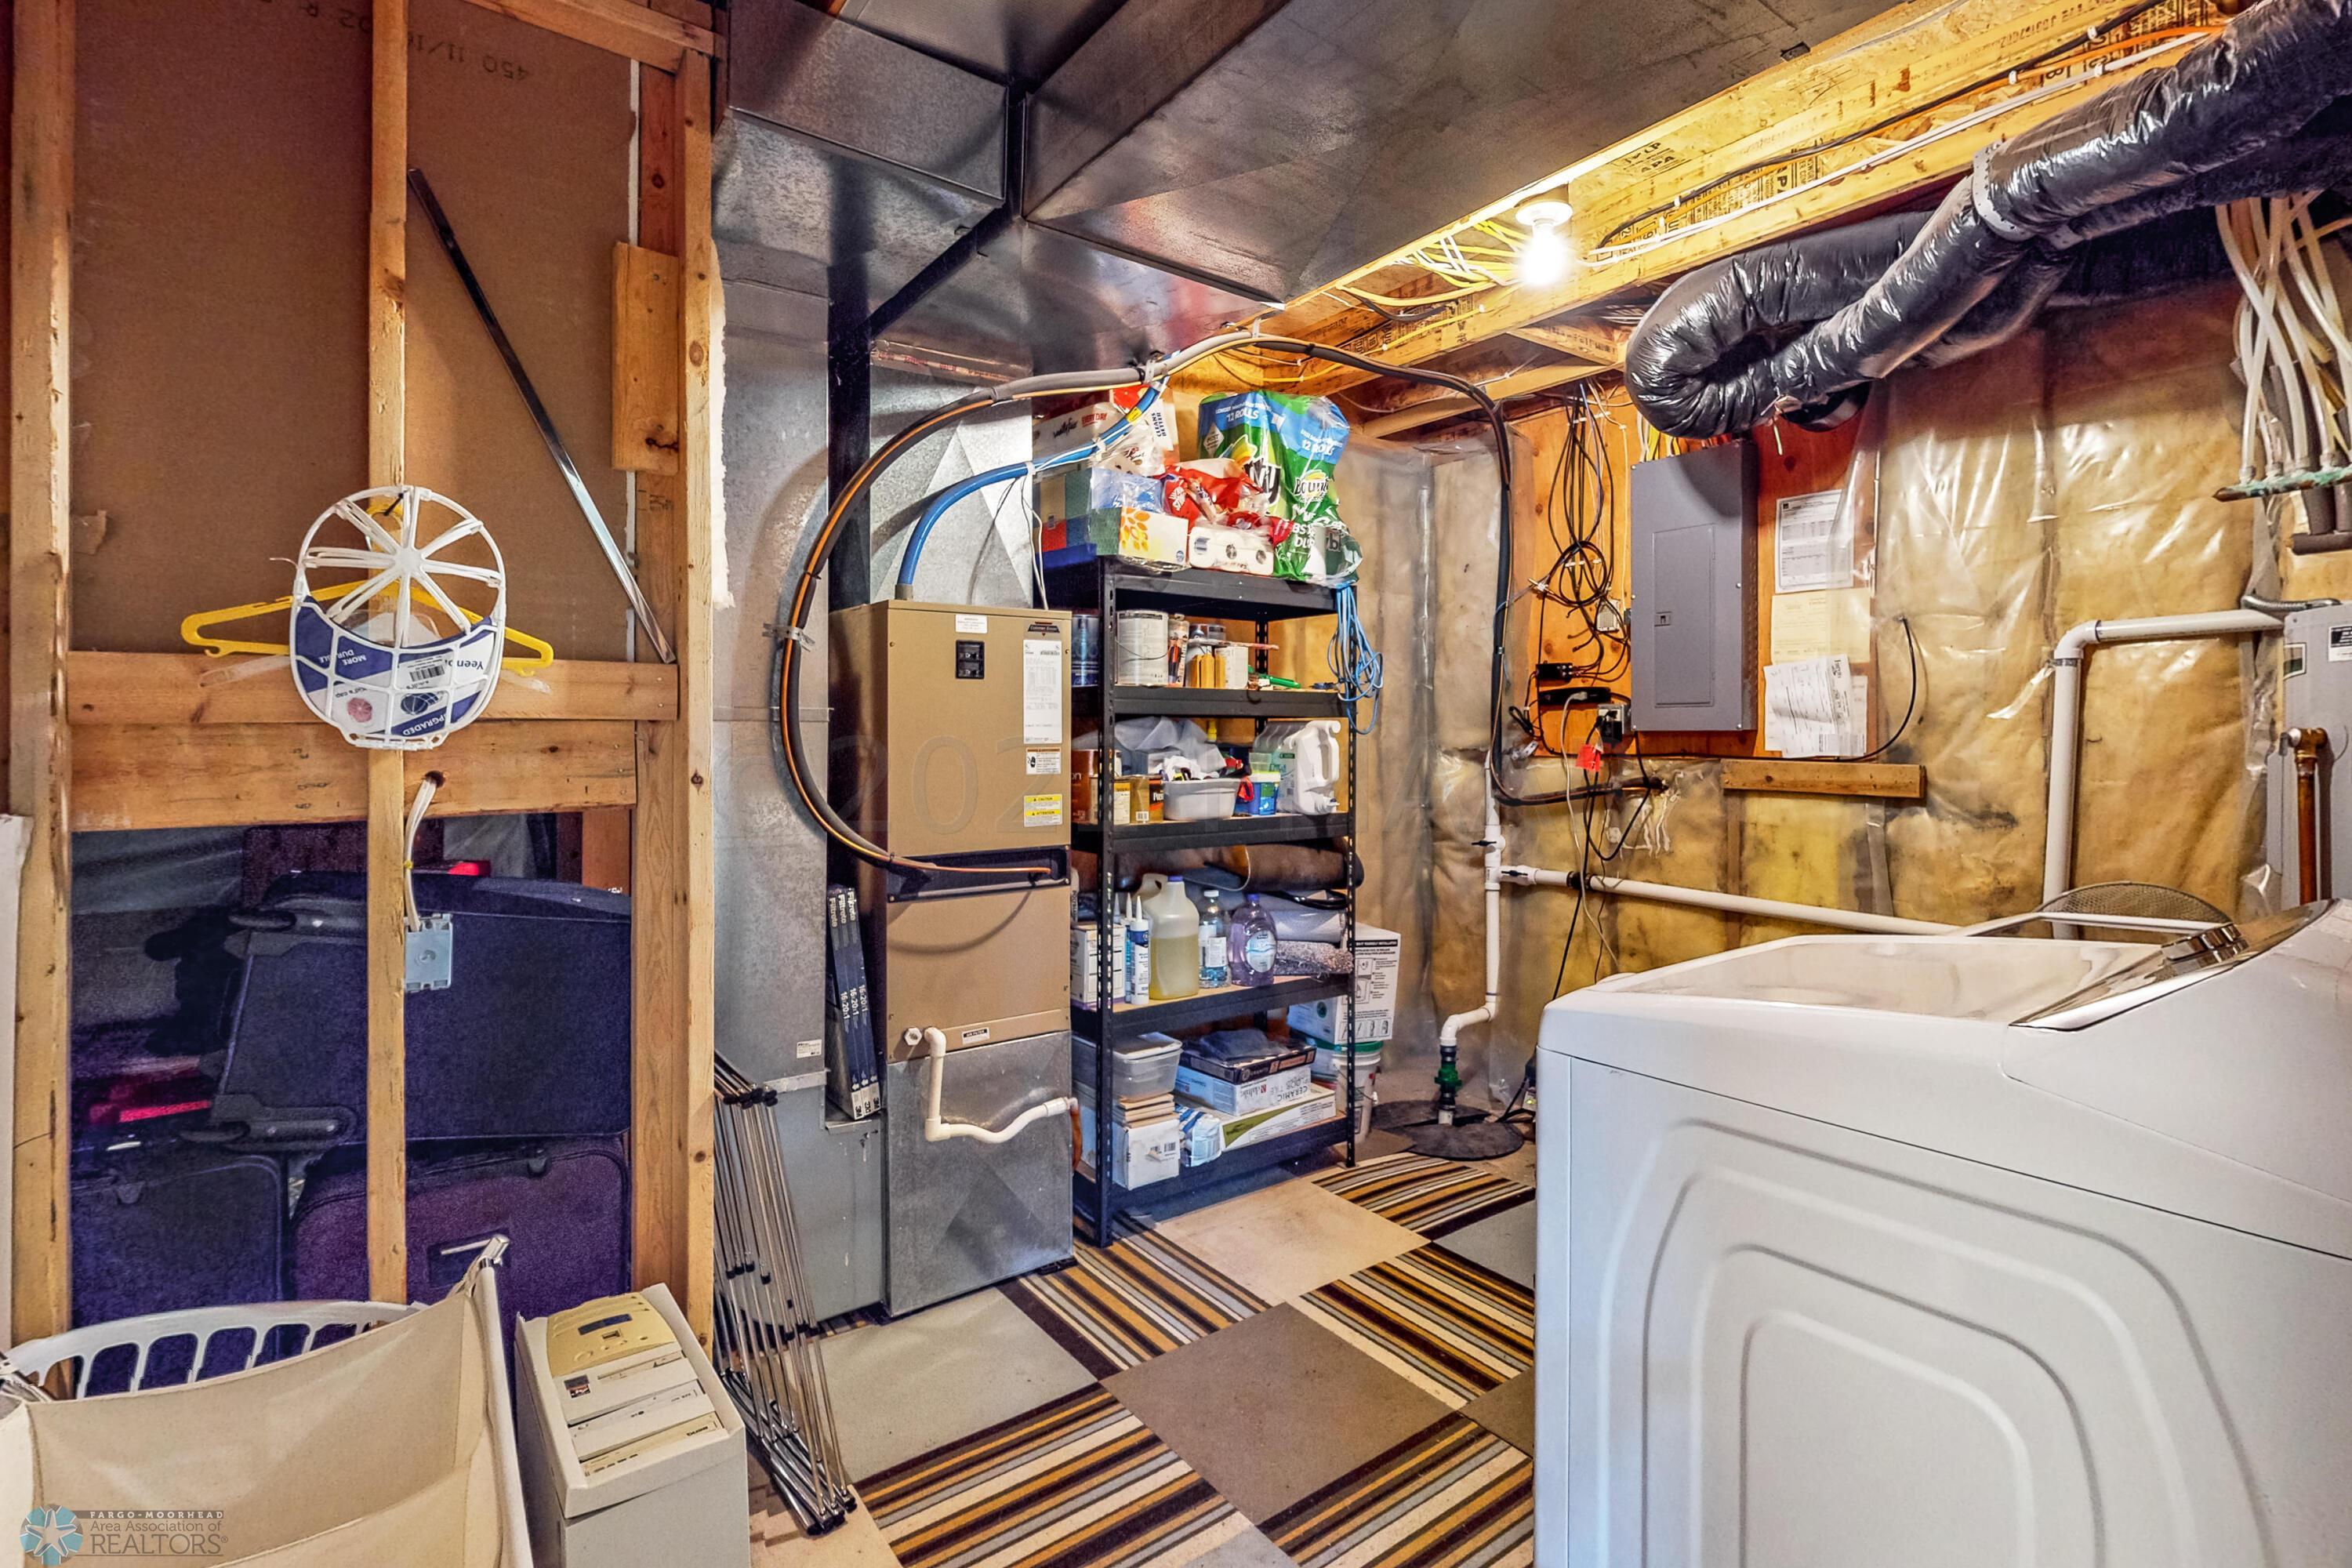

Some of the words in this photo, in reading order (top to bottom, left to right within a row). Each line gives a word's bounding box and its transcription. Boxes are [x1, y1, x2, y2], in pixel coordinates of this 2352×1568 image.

[482, 55, 530, 81] 450
[1640, 155, 1676, 174] APA
[1151, 412, 1162, 437] CLEANS
[1156, 412, 1167, 437] BETTER
[1235, 408, 1260, 420] ROLLS
[1301, 439, 1312, 451] 12
[341, 655, 367, 666] MORE
[403, 713, 447, 736] PGRADED
[829, 897, 839, 927] Filtrete
[838, 894, 848, 924] Filtrete
[847, 891, 858, 921] Filtrete
[840, 991, 851, 1020] 16x20x1
[849, 988, 859, 1016] 16x20x1
[858, 984, 869, 1013] 16x20x1
[873, 1096, 880, 1110] 3M
[1276, 1085, 1308, 1103] CERAMIC
[855, 1105, 862, 1118] 3M
